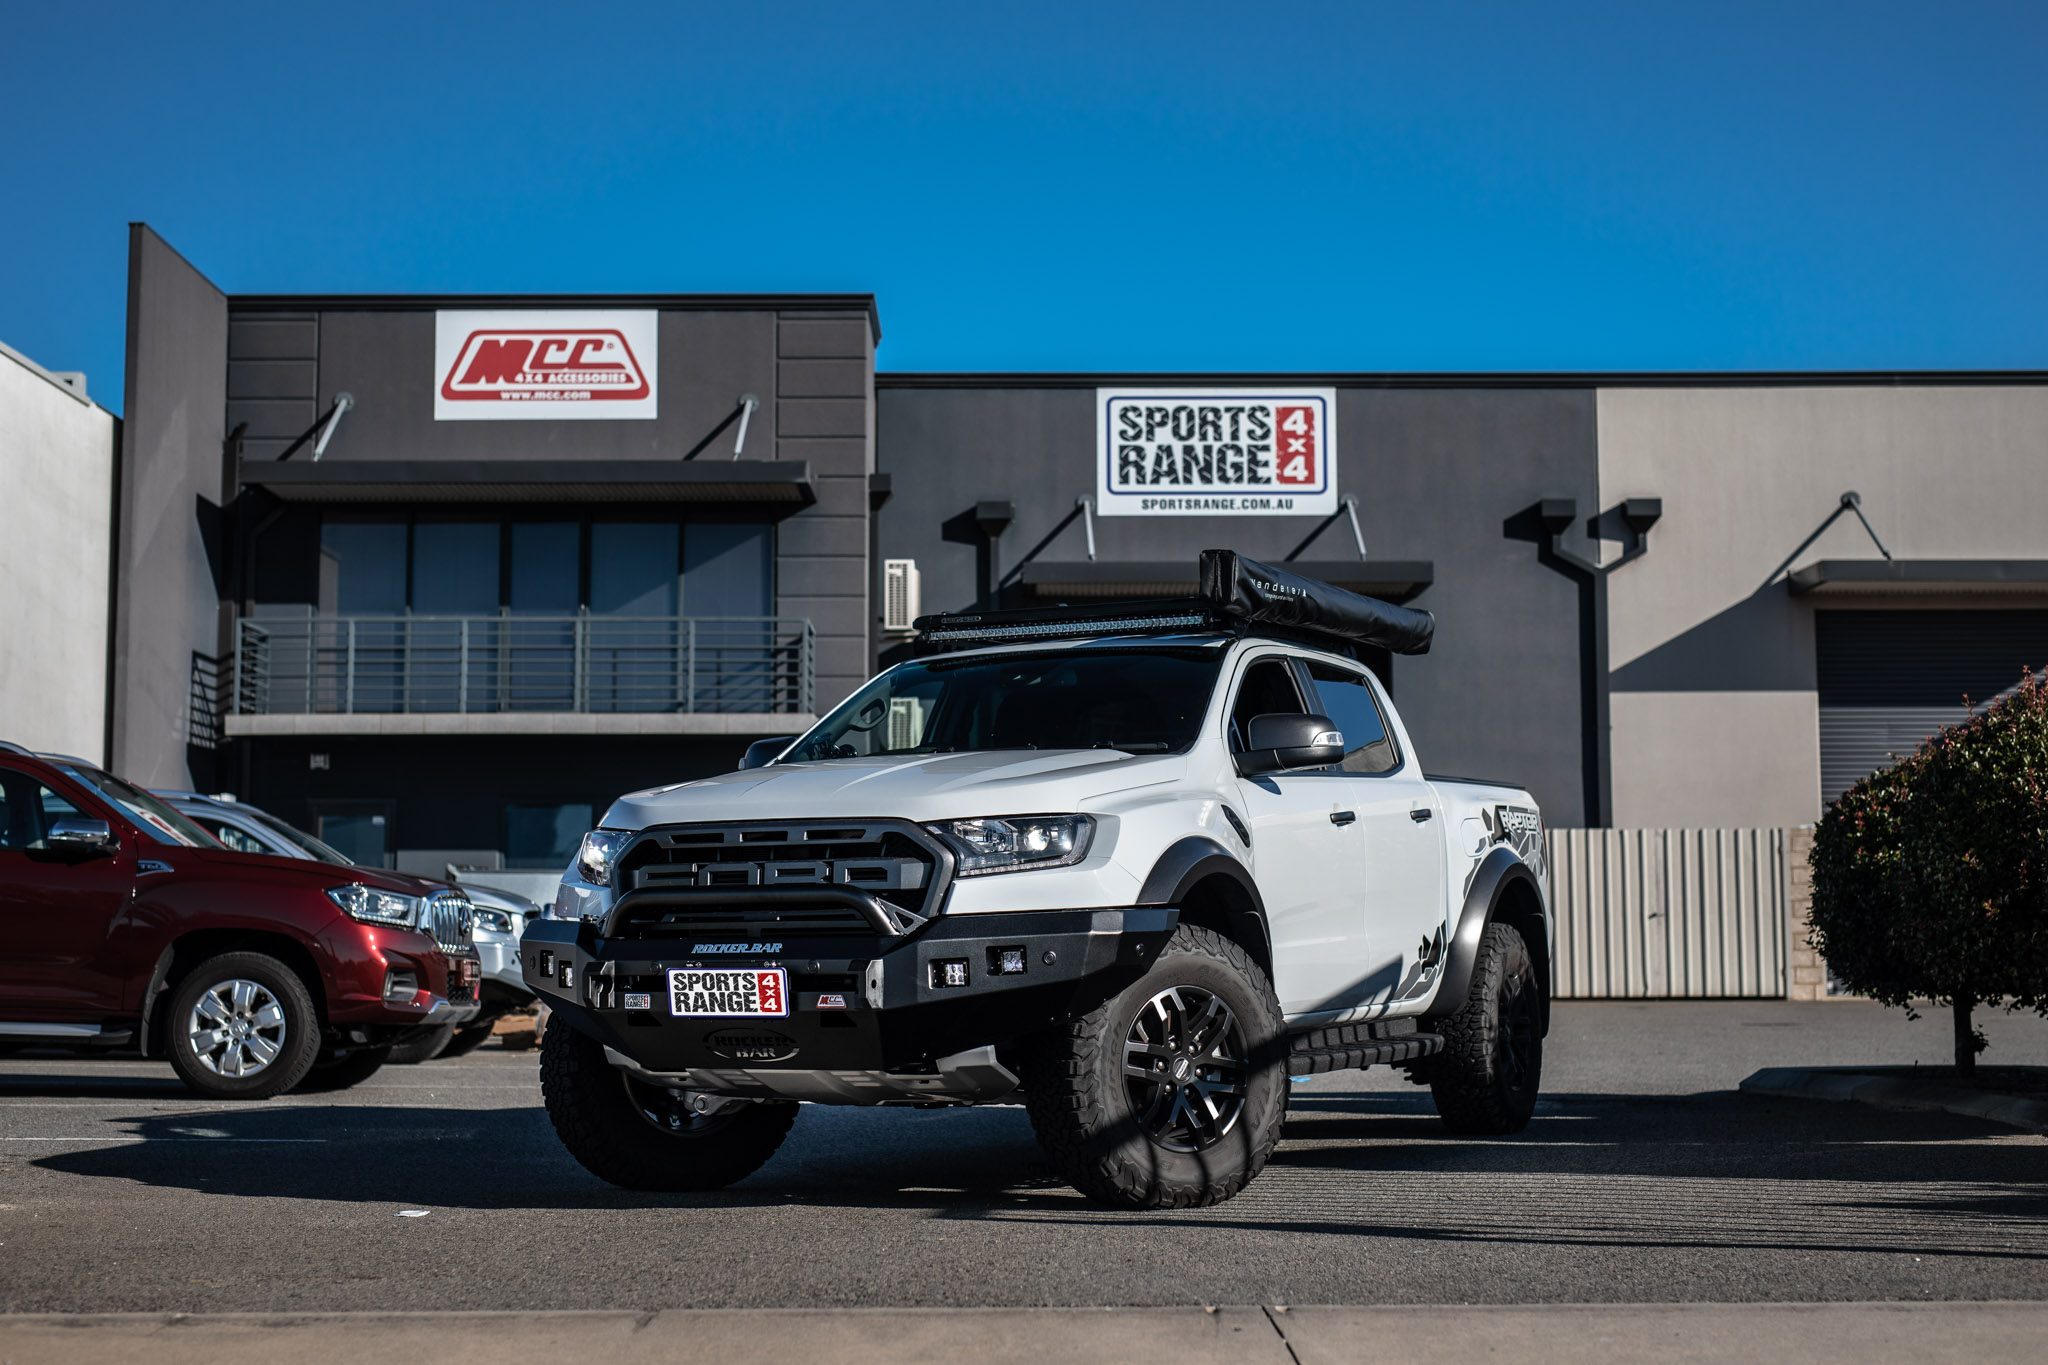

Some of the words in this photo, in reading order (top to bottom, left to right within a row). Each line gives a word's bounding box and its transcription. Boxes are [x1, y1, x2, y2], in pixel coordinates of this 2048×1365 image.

[458, 339, 627, 385] MCC
[548, 372, 627, 384] ACCESSORIES
[500, 391, 591, 401] www.mcc.com
[1118, 405, 1271, 442] SPORTS
[1118, 443, 1272, 485] RANGE
[1141, 498, 1294, 510] SPORTSRANGE.COM.AU
[1499, 811, 1538, 832] RAPTOR
[691, 943, 748, 954] ROCKER
[751, 943, 783, 953] BAR
[673, 972, 757, 991] SPORTS
[674, 991, 759, 1013] RANGE
